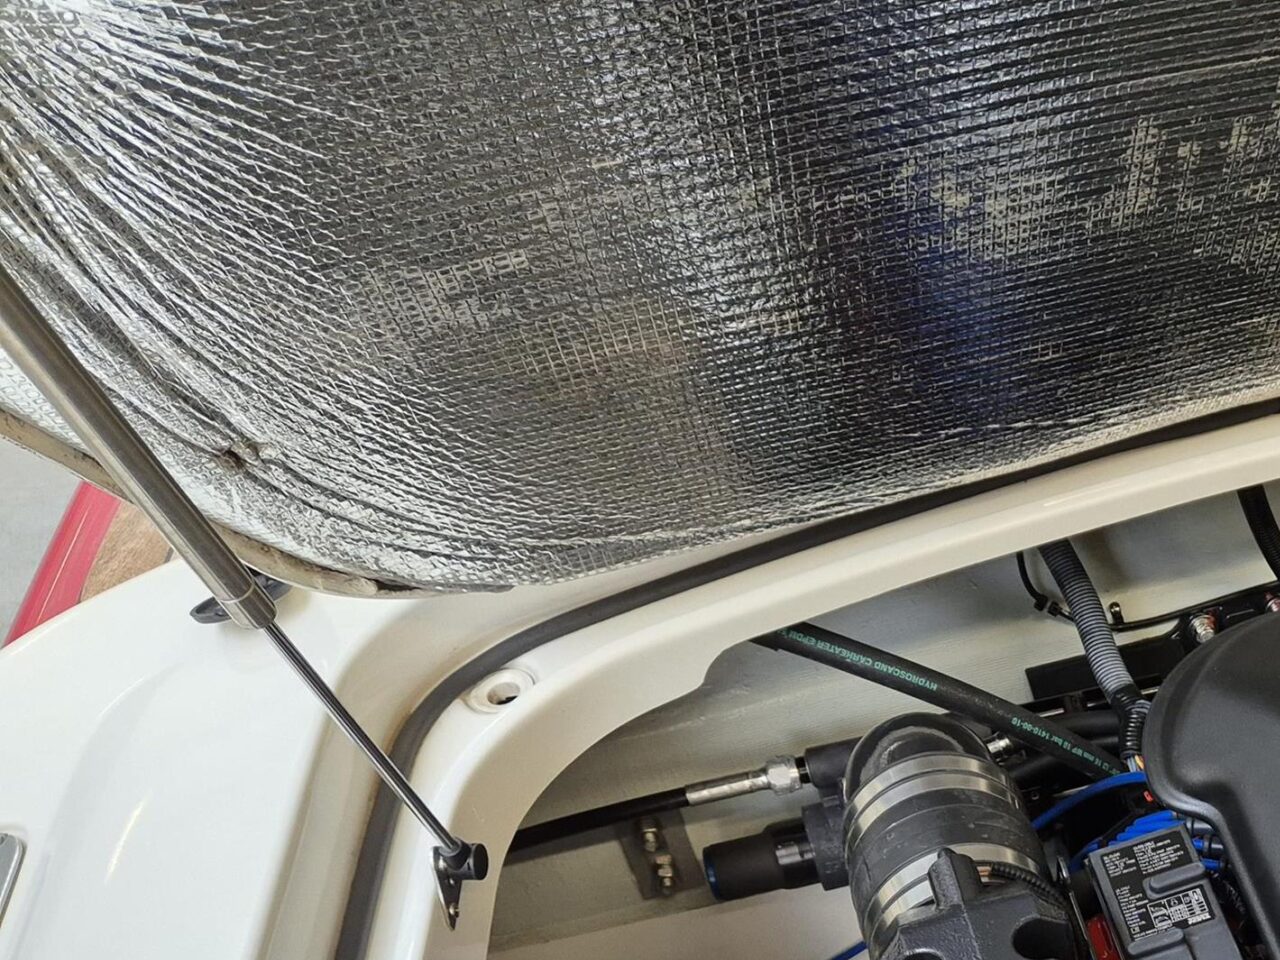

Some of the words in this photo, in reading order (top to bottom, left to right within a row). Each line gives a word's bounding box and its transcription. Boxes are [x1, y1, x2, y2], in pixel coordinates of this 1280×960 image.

[815, 638, 872, 666] CARHEATER
[873, 661, 938, 691] HYDROSCAND
[1051, 735, 1063, 746] bar
